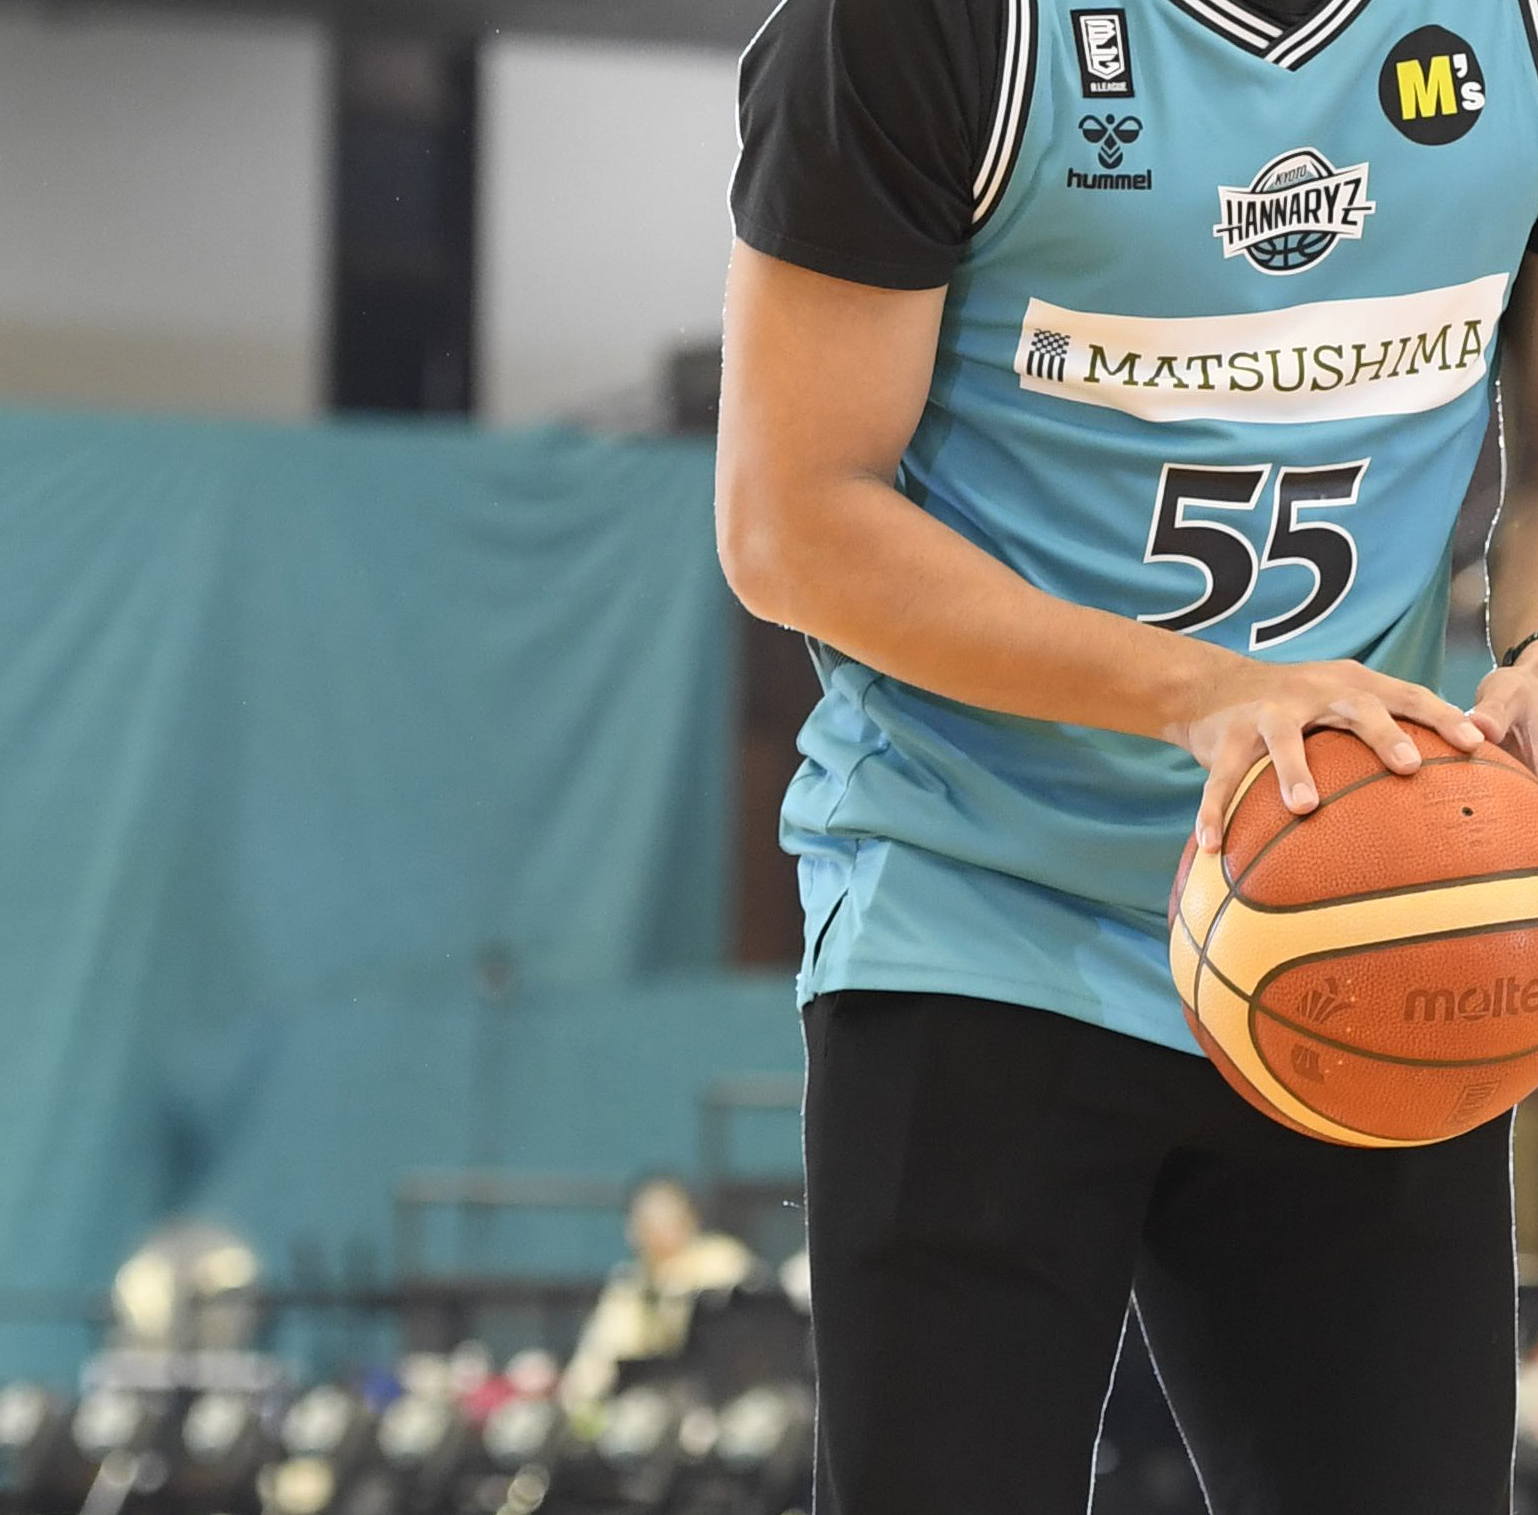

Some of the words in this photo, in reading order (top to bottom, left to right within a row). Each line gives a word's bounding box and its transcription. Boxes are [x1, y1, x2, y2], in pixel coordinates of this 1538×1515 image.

[1396, 52, 1486, 121] M's
[1066, 167, 1153, 191] hummel
[1274, 164, 1308, 186] KYOTO
[1216, 177, 1373, 245] HANNARYZ
[1083, 319, 1482, 392] MATSUSHIMA
[1136, 456, 1372, 651] 55
